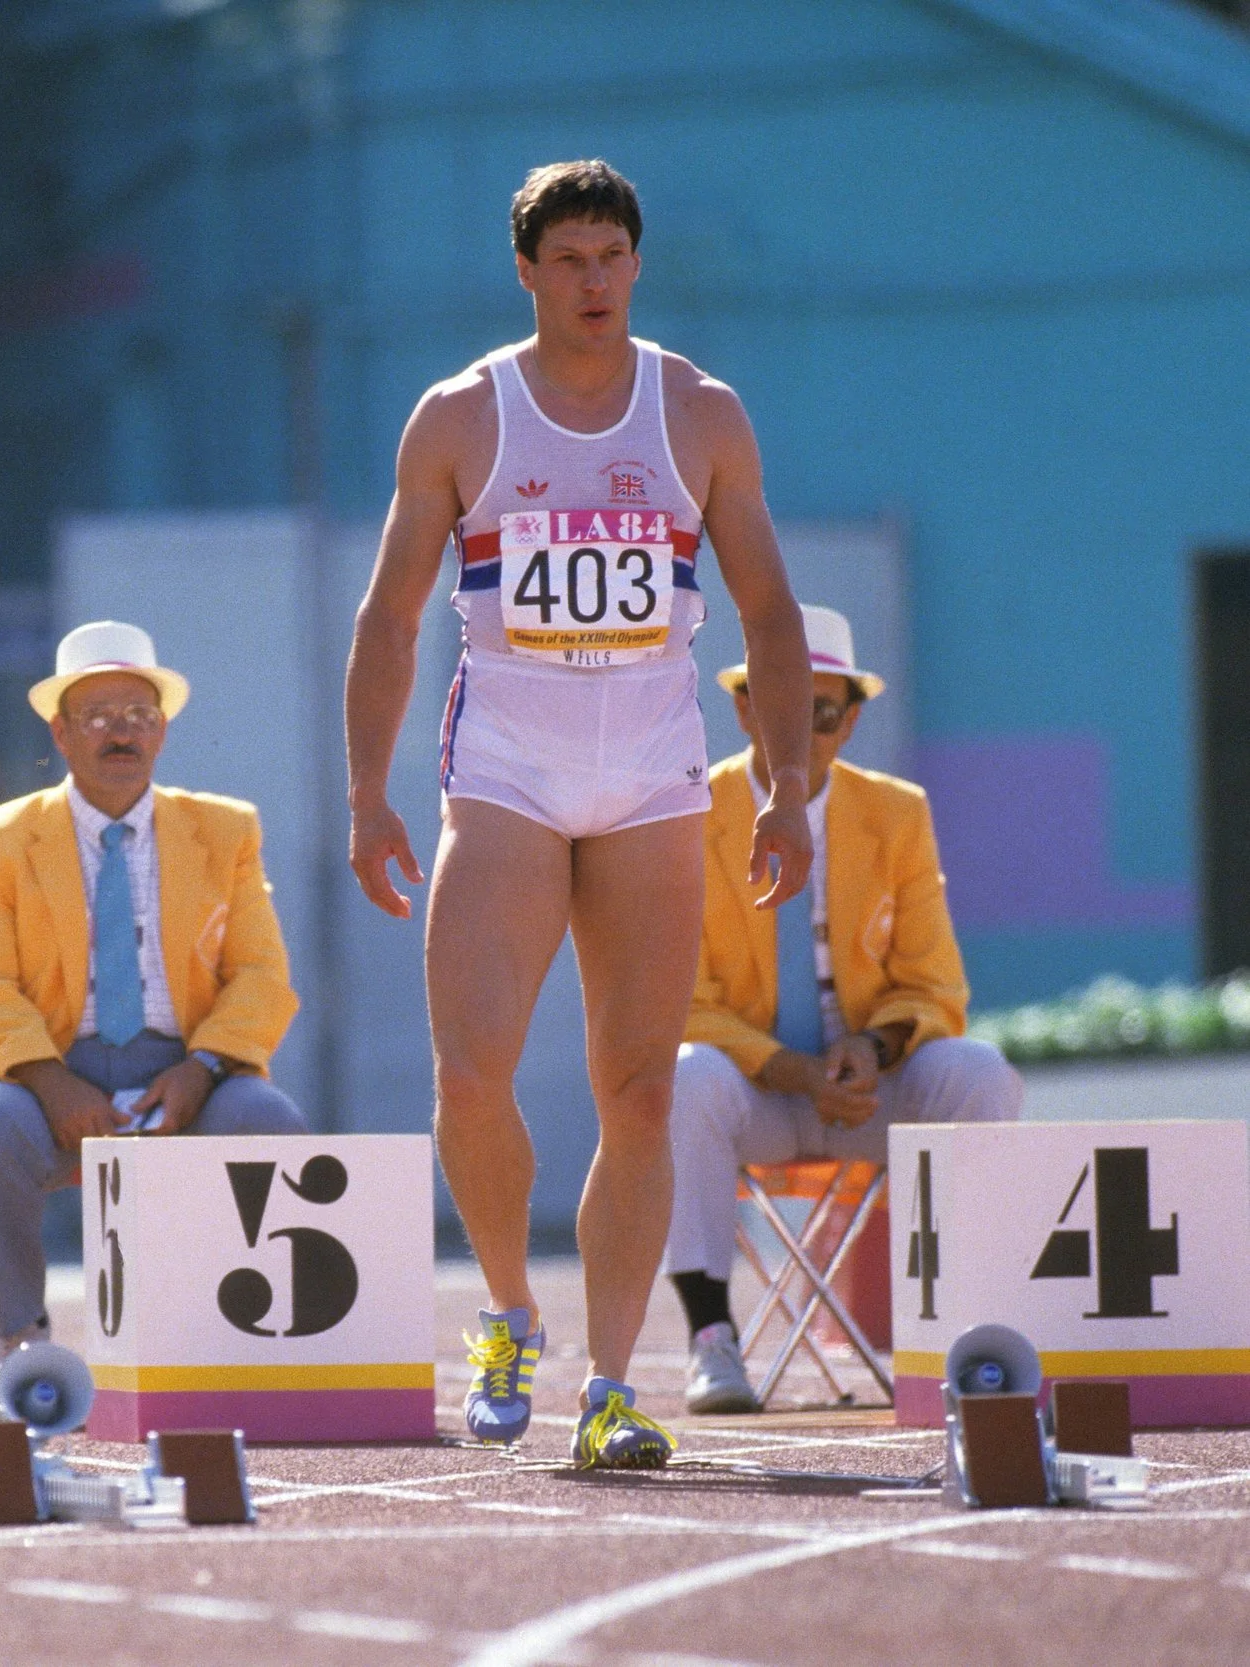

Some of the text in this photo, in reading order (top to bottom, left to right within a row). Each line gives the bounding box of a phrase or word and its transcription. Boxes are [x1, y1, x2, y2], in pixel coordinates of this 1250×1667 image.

[513, 547, 657, 624] 403
[513, 631, 544, 644] Games
[546, 633, 559, 644] of
[560, 632, 576, 644] the
[563, 649, 611, 666] WELLS
[97, 1156, 125, 1338] 5
[216, 1153, 359, 1338] 5
[907, 1149, 940, 1320] 4
[1029, 1146, 1180, 1319] 4
